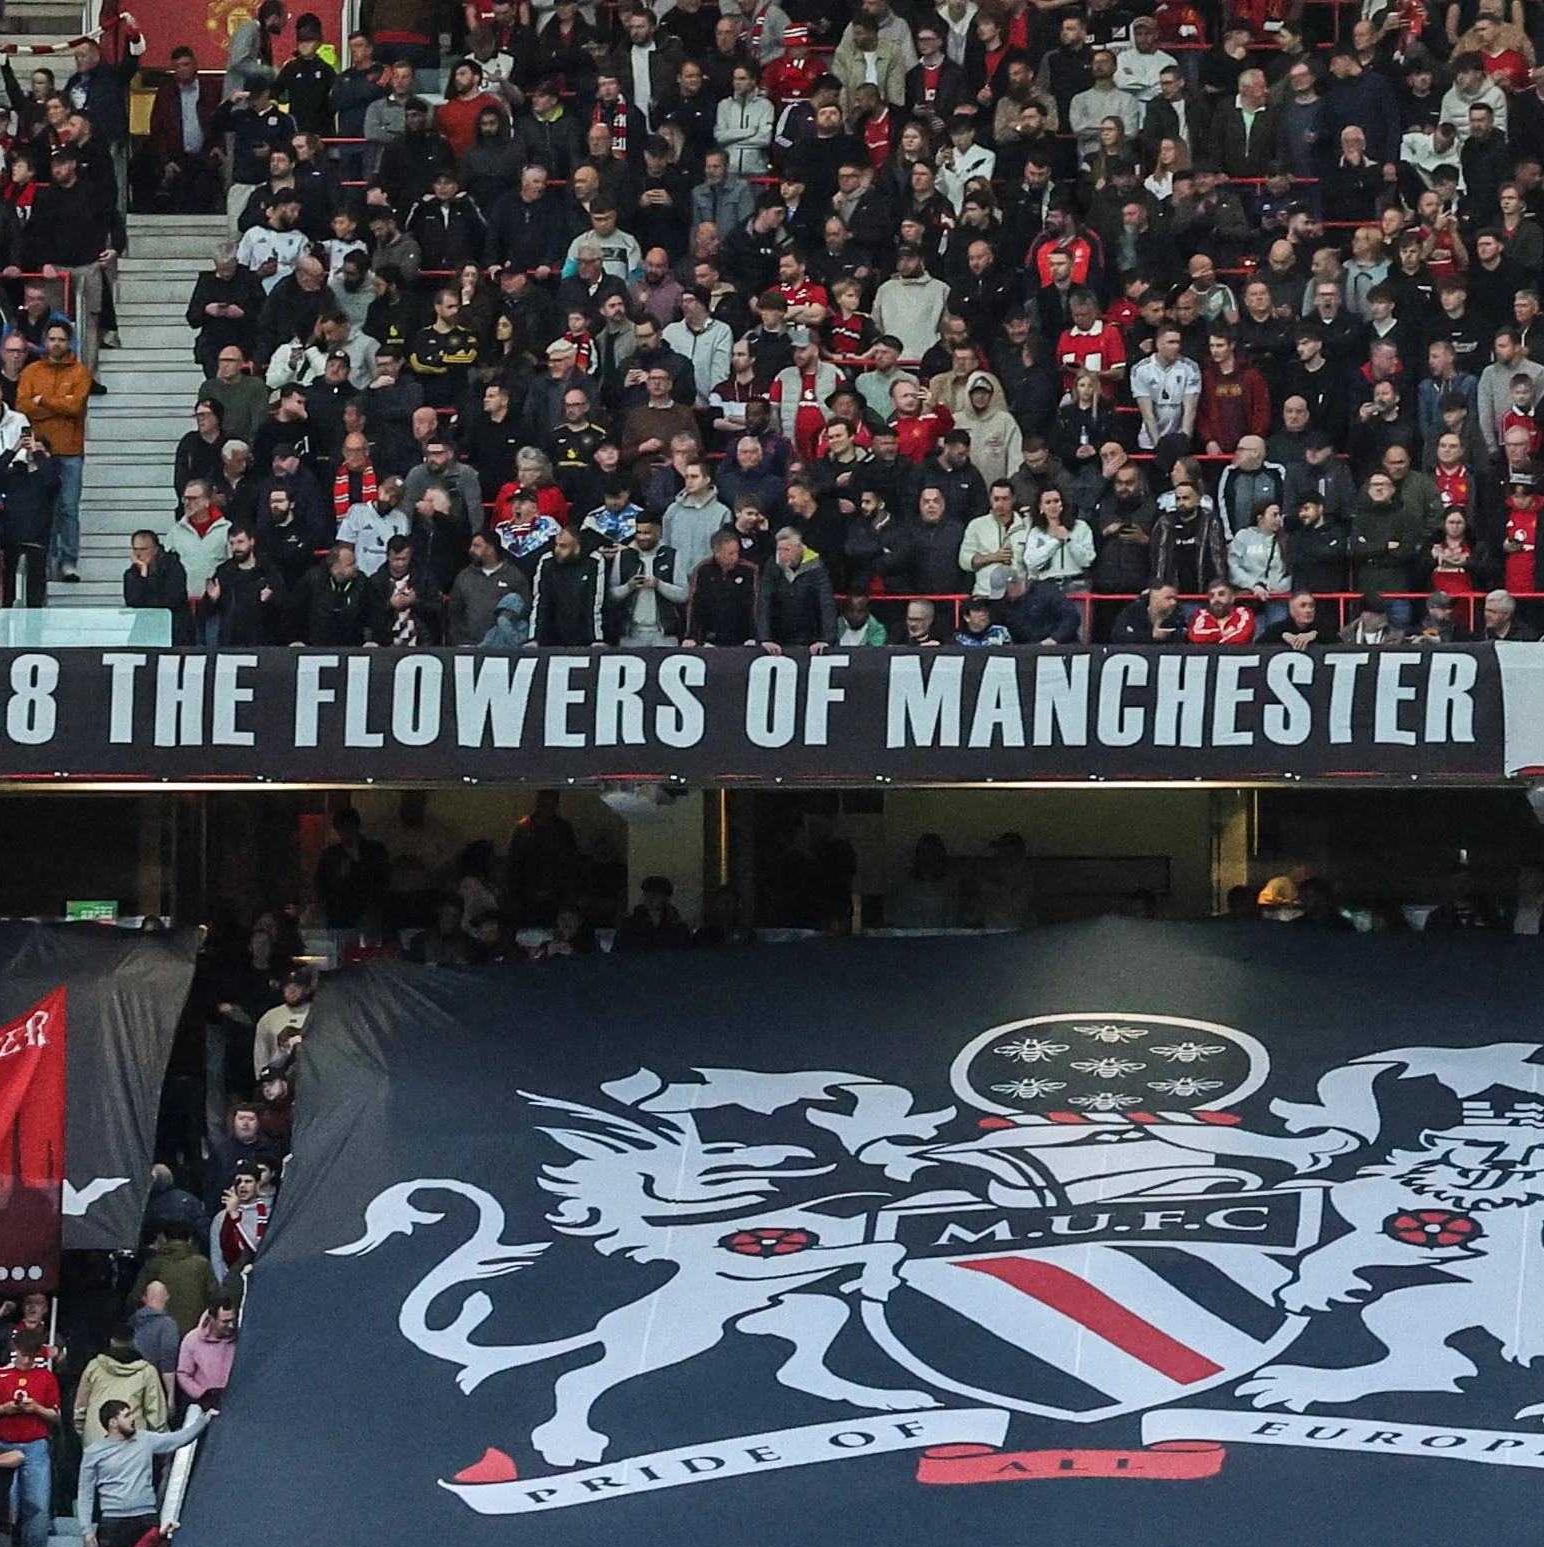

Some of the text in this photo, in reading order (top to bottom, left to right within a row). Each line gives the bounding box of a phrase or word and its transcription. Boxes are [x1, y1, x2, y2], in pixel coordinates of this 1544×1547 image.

[102, 653, 257, 747] THE
[294, 653, 707, 748] FLOWERS
[745, 653, 850, 748] OF
[886, 651, 1479, 749] MANCHESTER
[524, 1419, 927, 1505] PRIDE OF
[998, 1457, 1148, 1474] ALL
